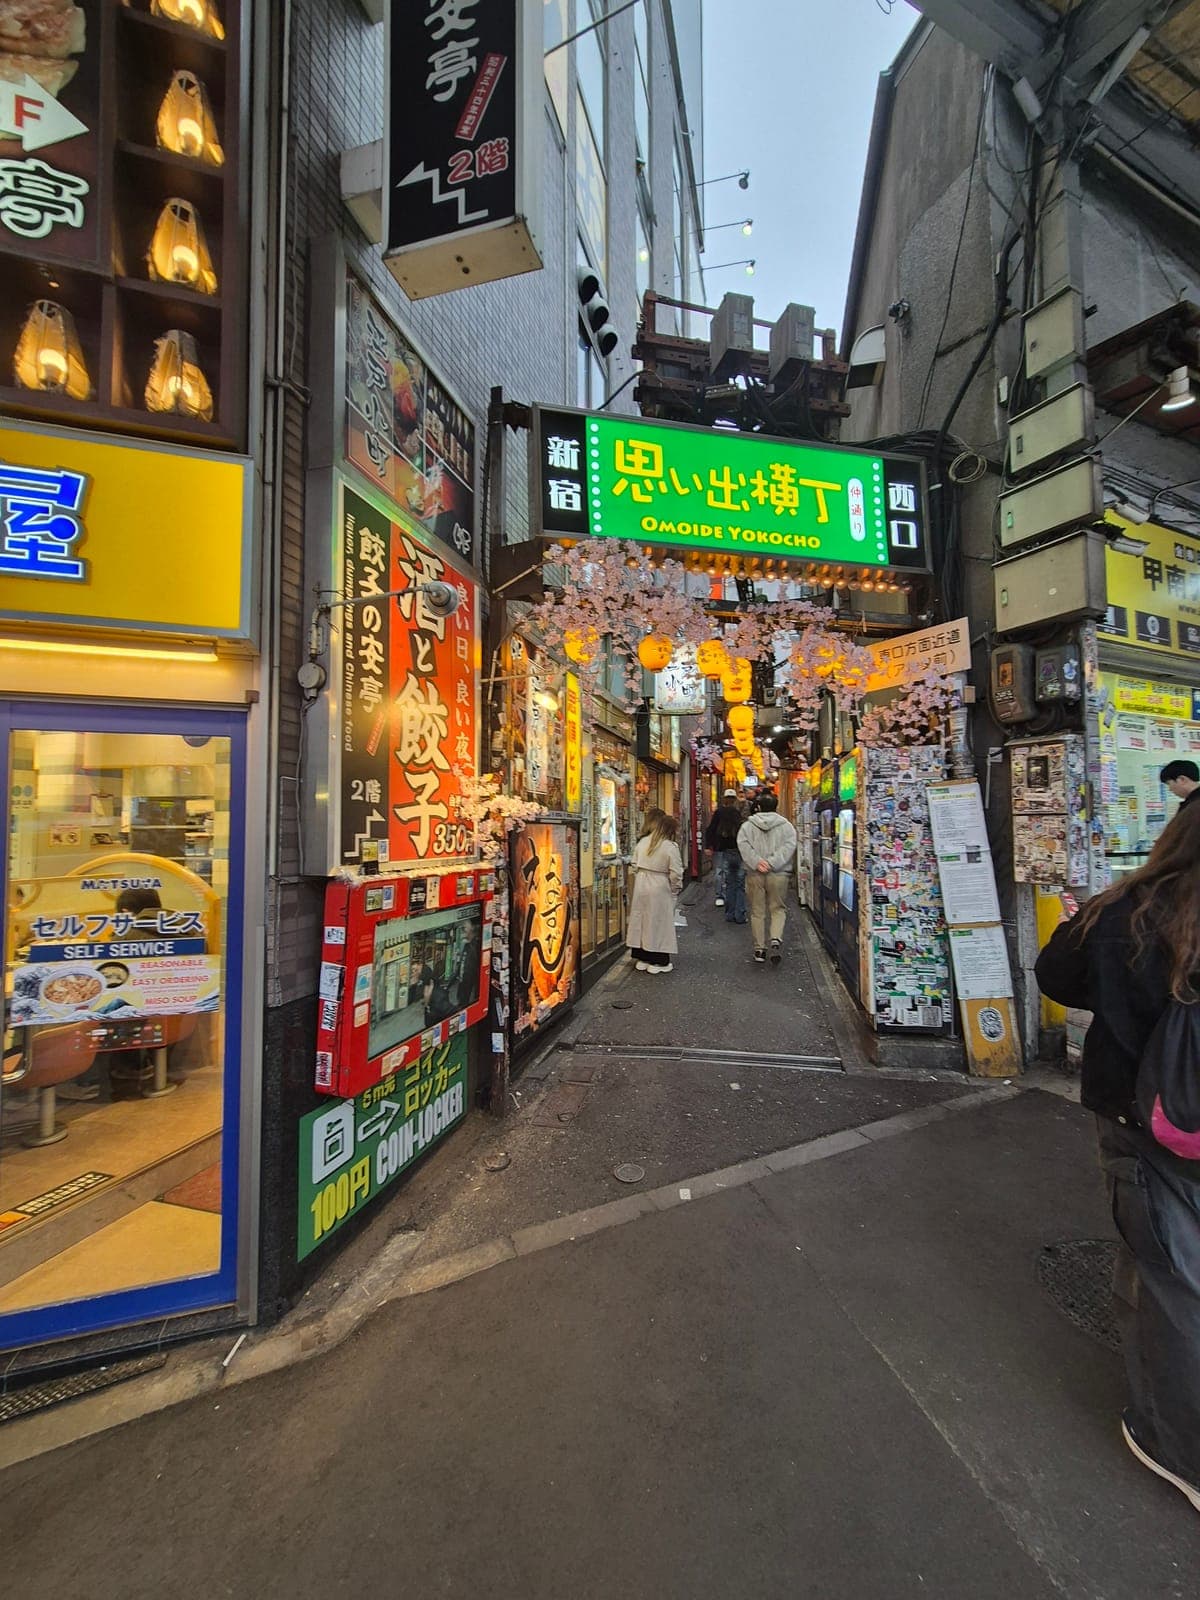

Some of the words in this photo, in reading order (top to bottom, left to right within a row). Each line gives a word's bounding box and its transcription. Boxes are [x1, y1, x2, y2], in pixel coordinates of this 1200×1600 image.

[447, 137, 509, 184] 2階
[547, 436, 582, 511] 新宿
[612, 439, 842, 523] 思い出横丁
[641, 516, 723, 539] OMOIDE
[728, 526, 821, 549] YOKOCHO
[850, 486, 862, 534] 仲通り
[888, 482, 918, 548] 西口
[358, 526, 386, 713] 餃子の安亭
[393, 535, 451, 857] 酒と餃子
[344, 720, 353, 752] food
[351, 780, 381, 804] 2階
[32, 911, 204, 938] セルフサービス
[63, 945, 104, 959] SELF
[109, 941, 175, 957] SERVICE
[140, 959, 203, 969] REASONABLE
[160, 975, 209, 985] ORDERING
[405, 1041, 451, 1087] コイン
[405, 1063, 461, 1118] ロッカー
[376, 1081, 463, 1185] COIN-LOCKER
[311, 1155, 370, 1241] 100円
